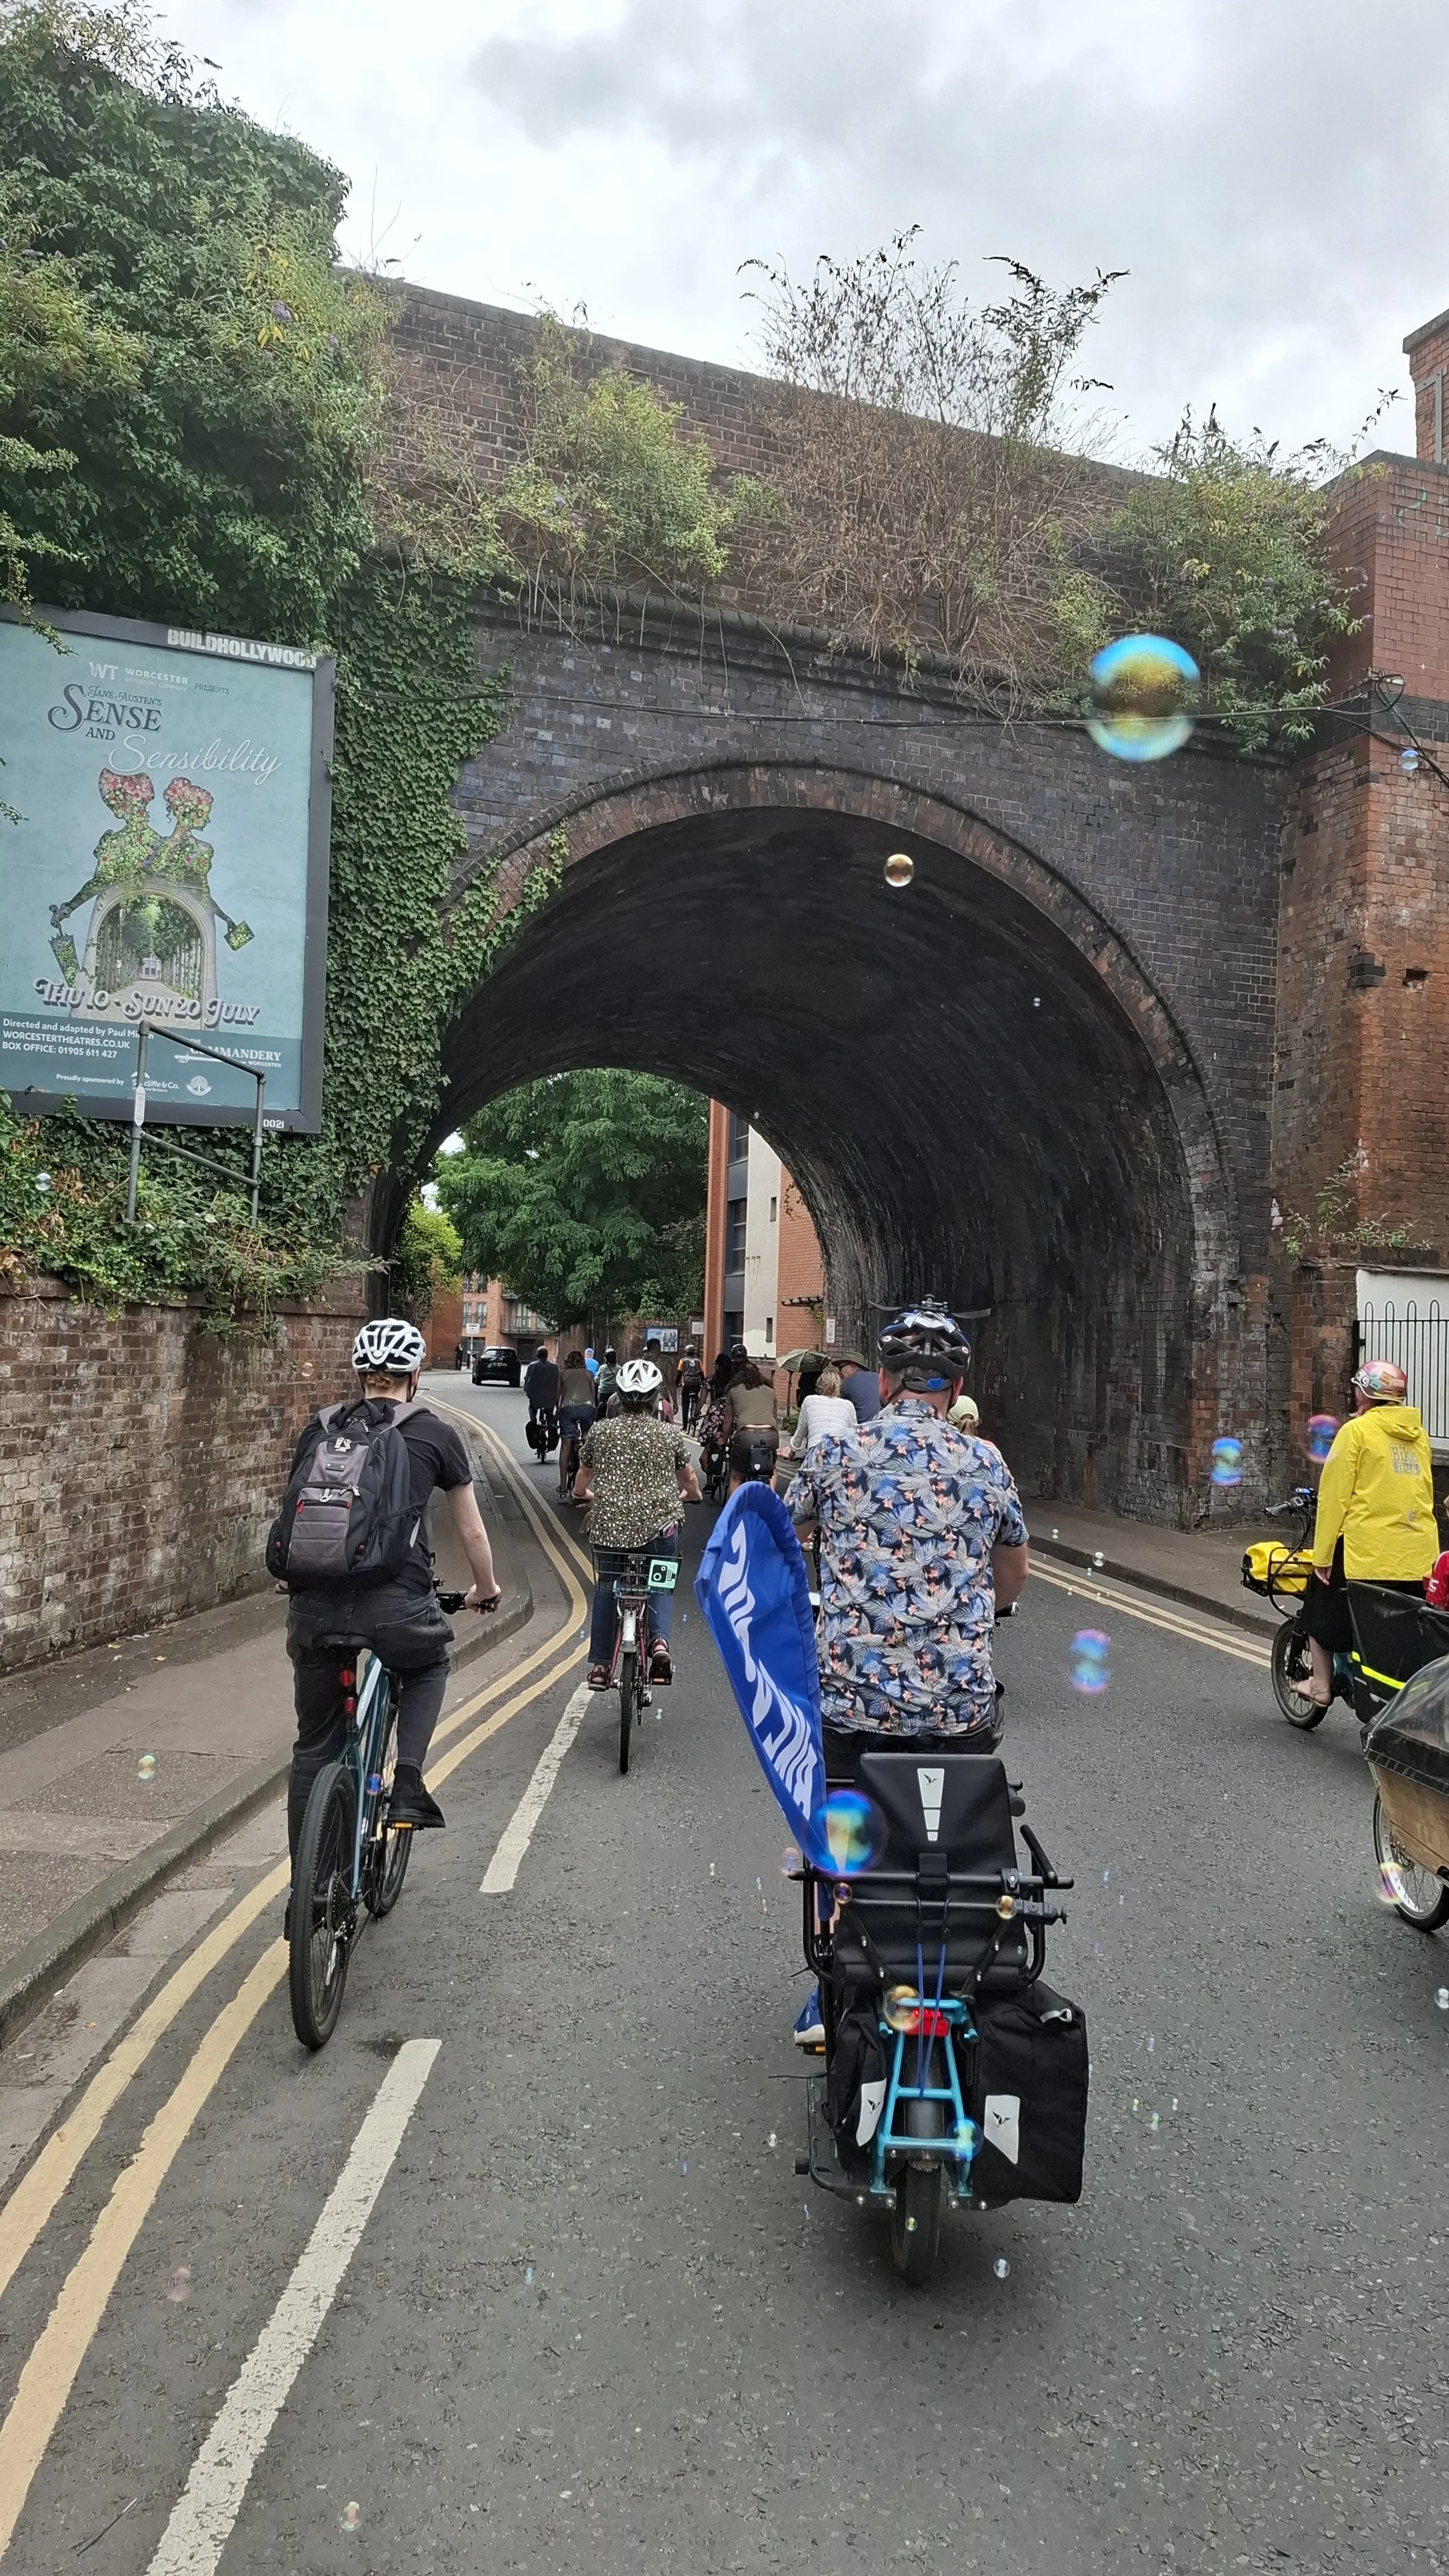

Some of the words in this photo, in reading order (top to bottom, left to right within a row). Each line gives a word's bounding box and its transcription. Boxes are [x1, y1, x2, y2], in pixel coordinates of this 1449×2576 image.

[89, 662, 119, 681] WT
[125, 667, 189, 685] WORCESTER
[125, 677, 158, 688] REPERTORY
[159, 681, 188, 692] COMPANY
[194, 682, 230, 695] PRESENTS
[88, 685, 114, 699] JANE
[115, 691, 163, 706] AUSTEN'S
[48, 683, 163, 732] SENSE
[85, 726, 115, 740] AND
[108, 734, 282, 785] Sensibility
[33, 977, 85, 1009] THU
[86, 990, 111, 1011] 10
[122, 990, 174, 1020] SUN
[173, 998, 202, 1018] 20
[203, 998, 260, 1026] JULY
[3, 1018, 41, 1029] Directed
[42, 1022, 58, 1030] and
[59, 1024, 94, 1034] adapted
[96, 1027, 106, 1037] by
[108, 1028, 126, 1037] Paul
[3, 1030, 130, 1049] WORCESTERTHEATRES.CO.UK
[2, 1042, 21, 1051] BOX
[23, 1044, 56, 1054] OFFICE:
[58, 1047, 84, 1056] 01905
[101, 1051, 118, 1059] 427
[56, 1074, 82, 1082] Proudly
[132, 1079, 161, 1088] Scliffe
[1391, 1445, 1417, 1463] Bike
